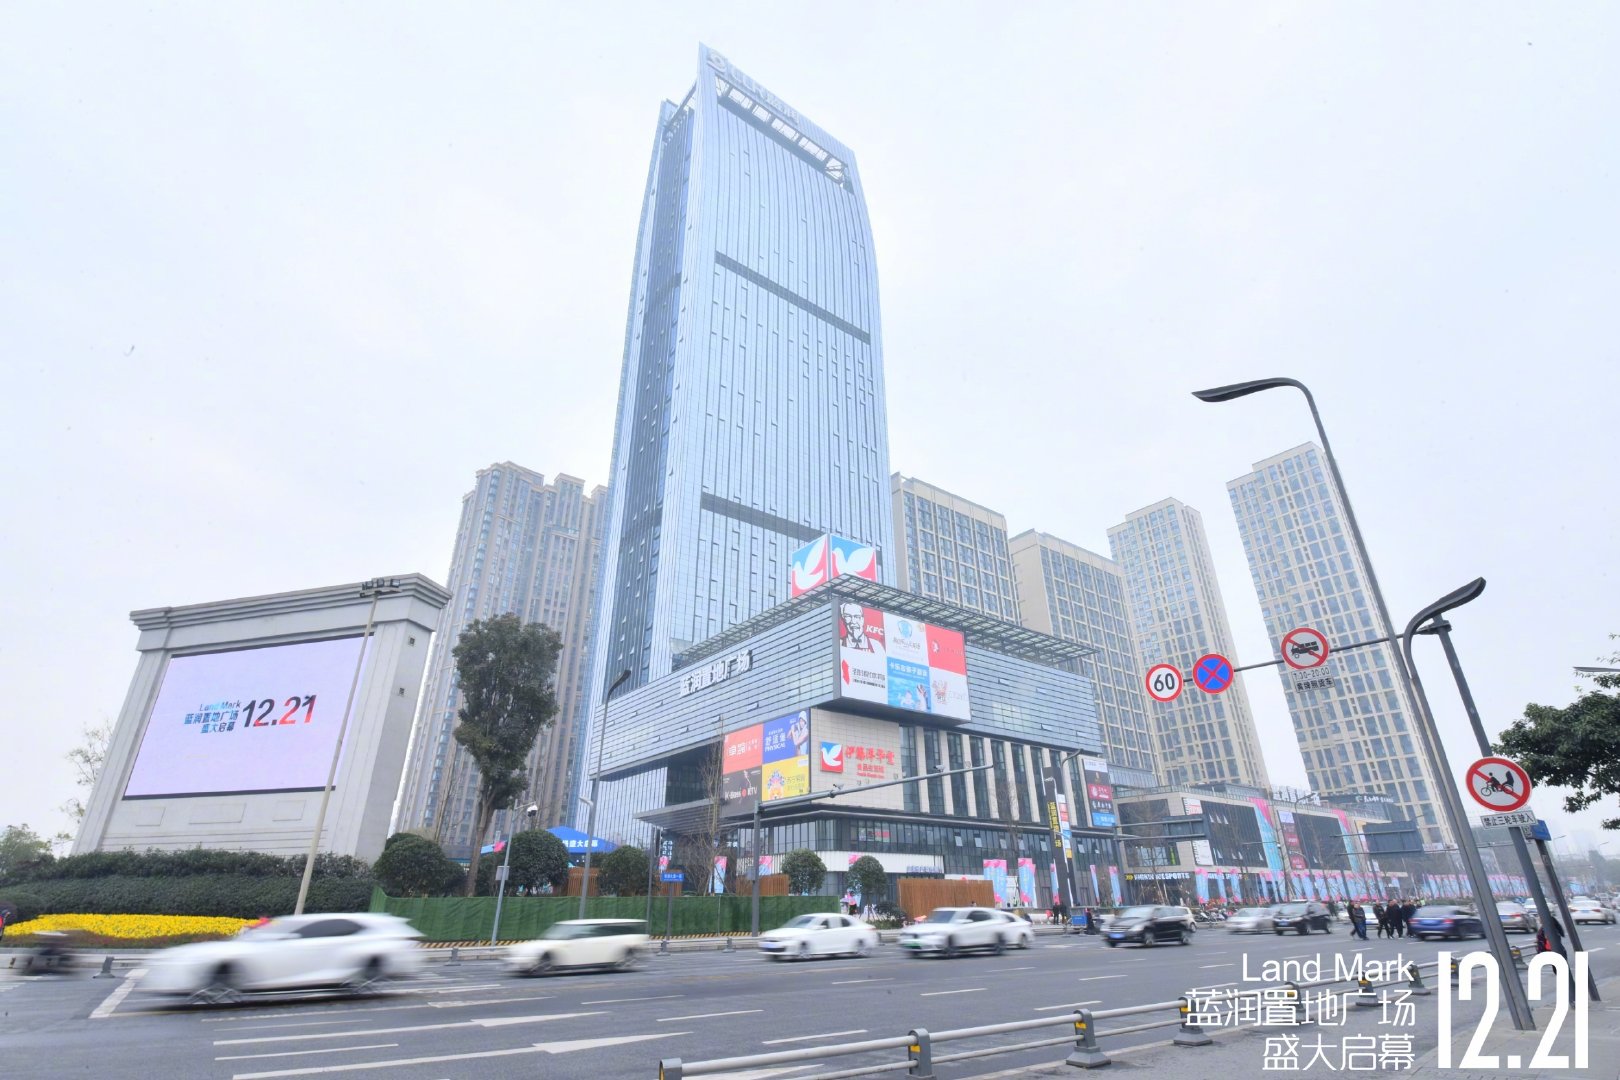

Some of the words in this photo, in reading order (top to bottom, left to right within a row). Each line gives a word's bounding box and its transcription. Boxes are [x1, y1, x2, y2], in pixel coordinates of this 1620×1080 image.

[866, 624, 885, 636] KFC
[680, 649, 753, 698] 蓝润置地广场
[1154, 672, 1175, 692] 60
[221, 699, 240, 710] Mark
[242, 694, 317, 728] 12.21
[184, 711, 240, 725] 蓝润置地广场
[201, 721, 236, 733] 盛大启幕
[1483, 812, 1534, 827] 禁止三轮车驶入
